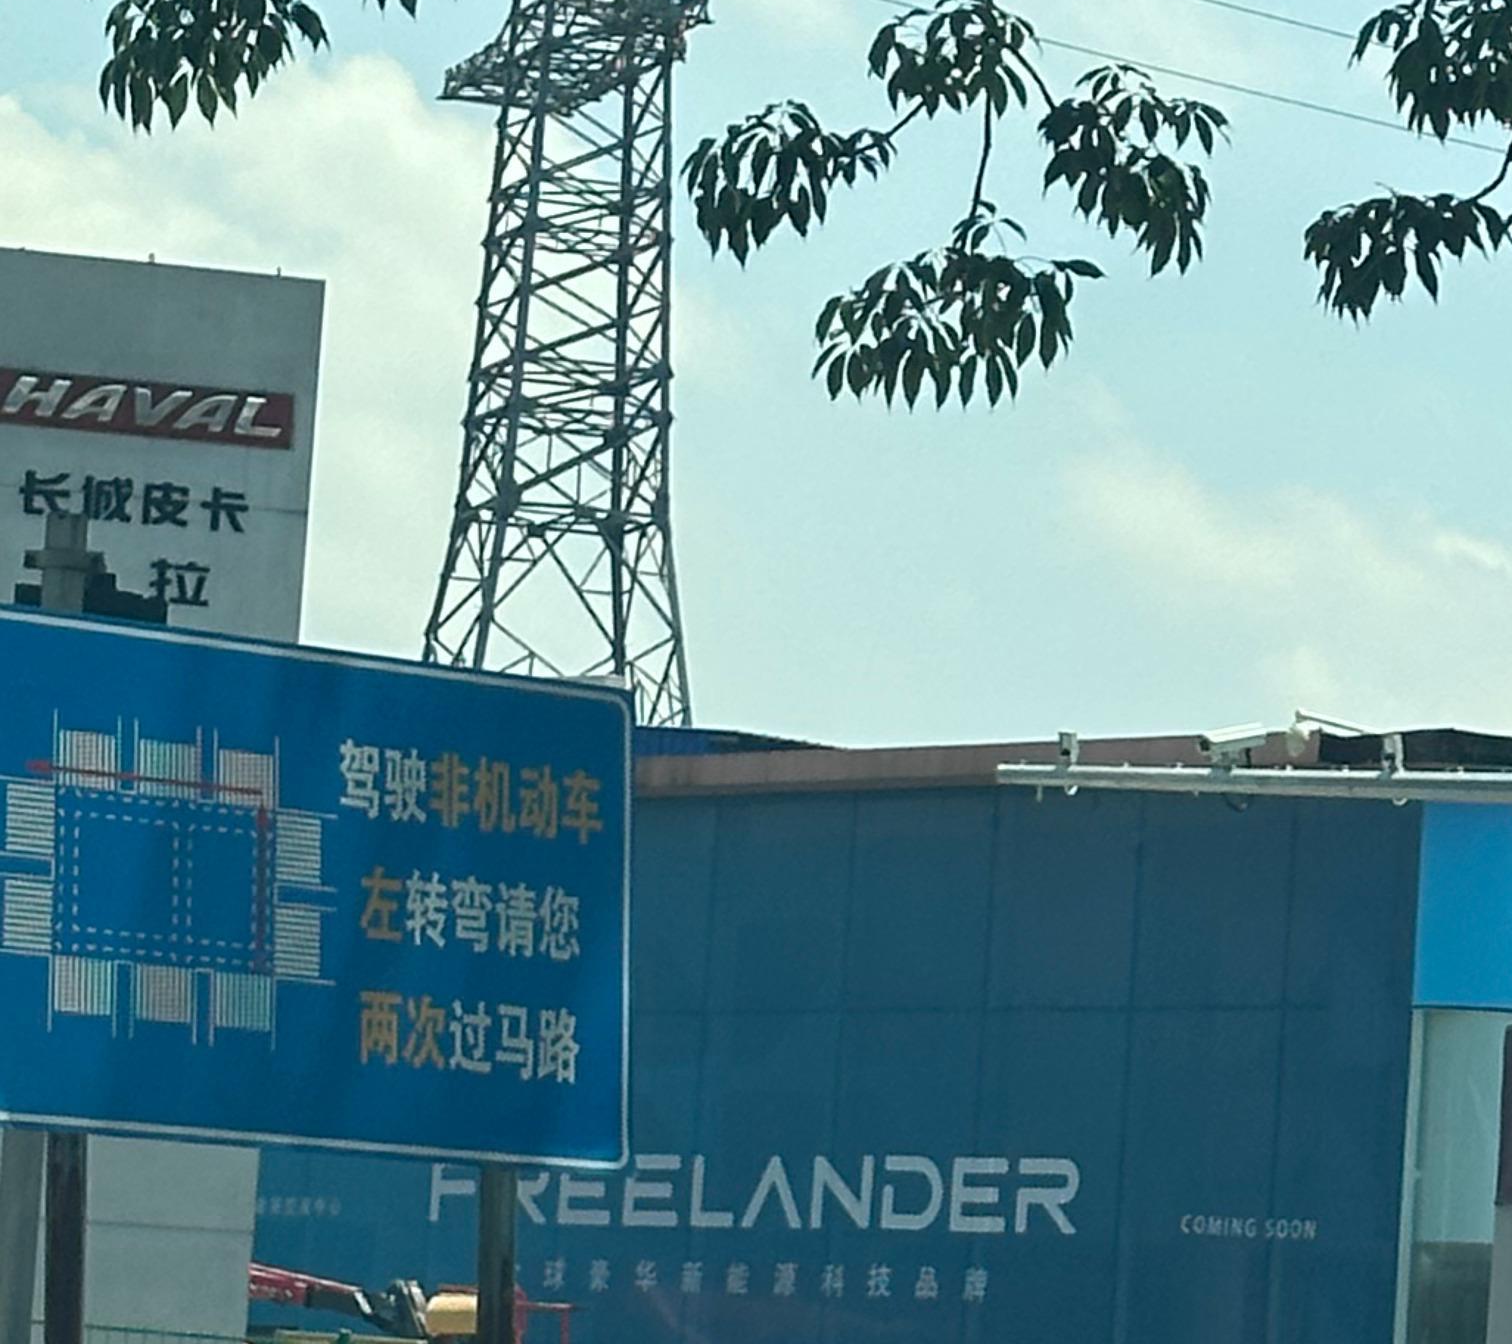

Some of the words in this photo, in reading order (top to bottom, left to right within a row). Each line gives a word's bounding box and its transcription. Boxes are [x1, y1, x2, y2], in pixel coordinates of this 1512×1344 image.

[3, 375, 282, 438] HAVAL
[19, 469, 249, 533] 长城皮卡
[339, 738, 602, 844] 驾驶非机动车
[360, 866, 580, 960] 左转弯请您
[360, 991, 580, 1084] 两次过马路
[428, 1155, 1081, 1235] FREELANDER
[1180, 1214, 1257, 1238] COMING
[1264, 1217, 1317, 1240] SOON
